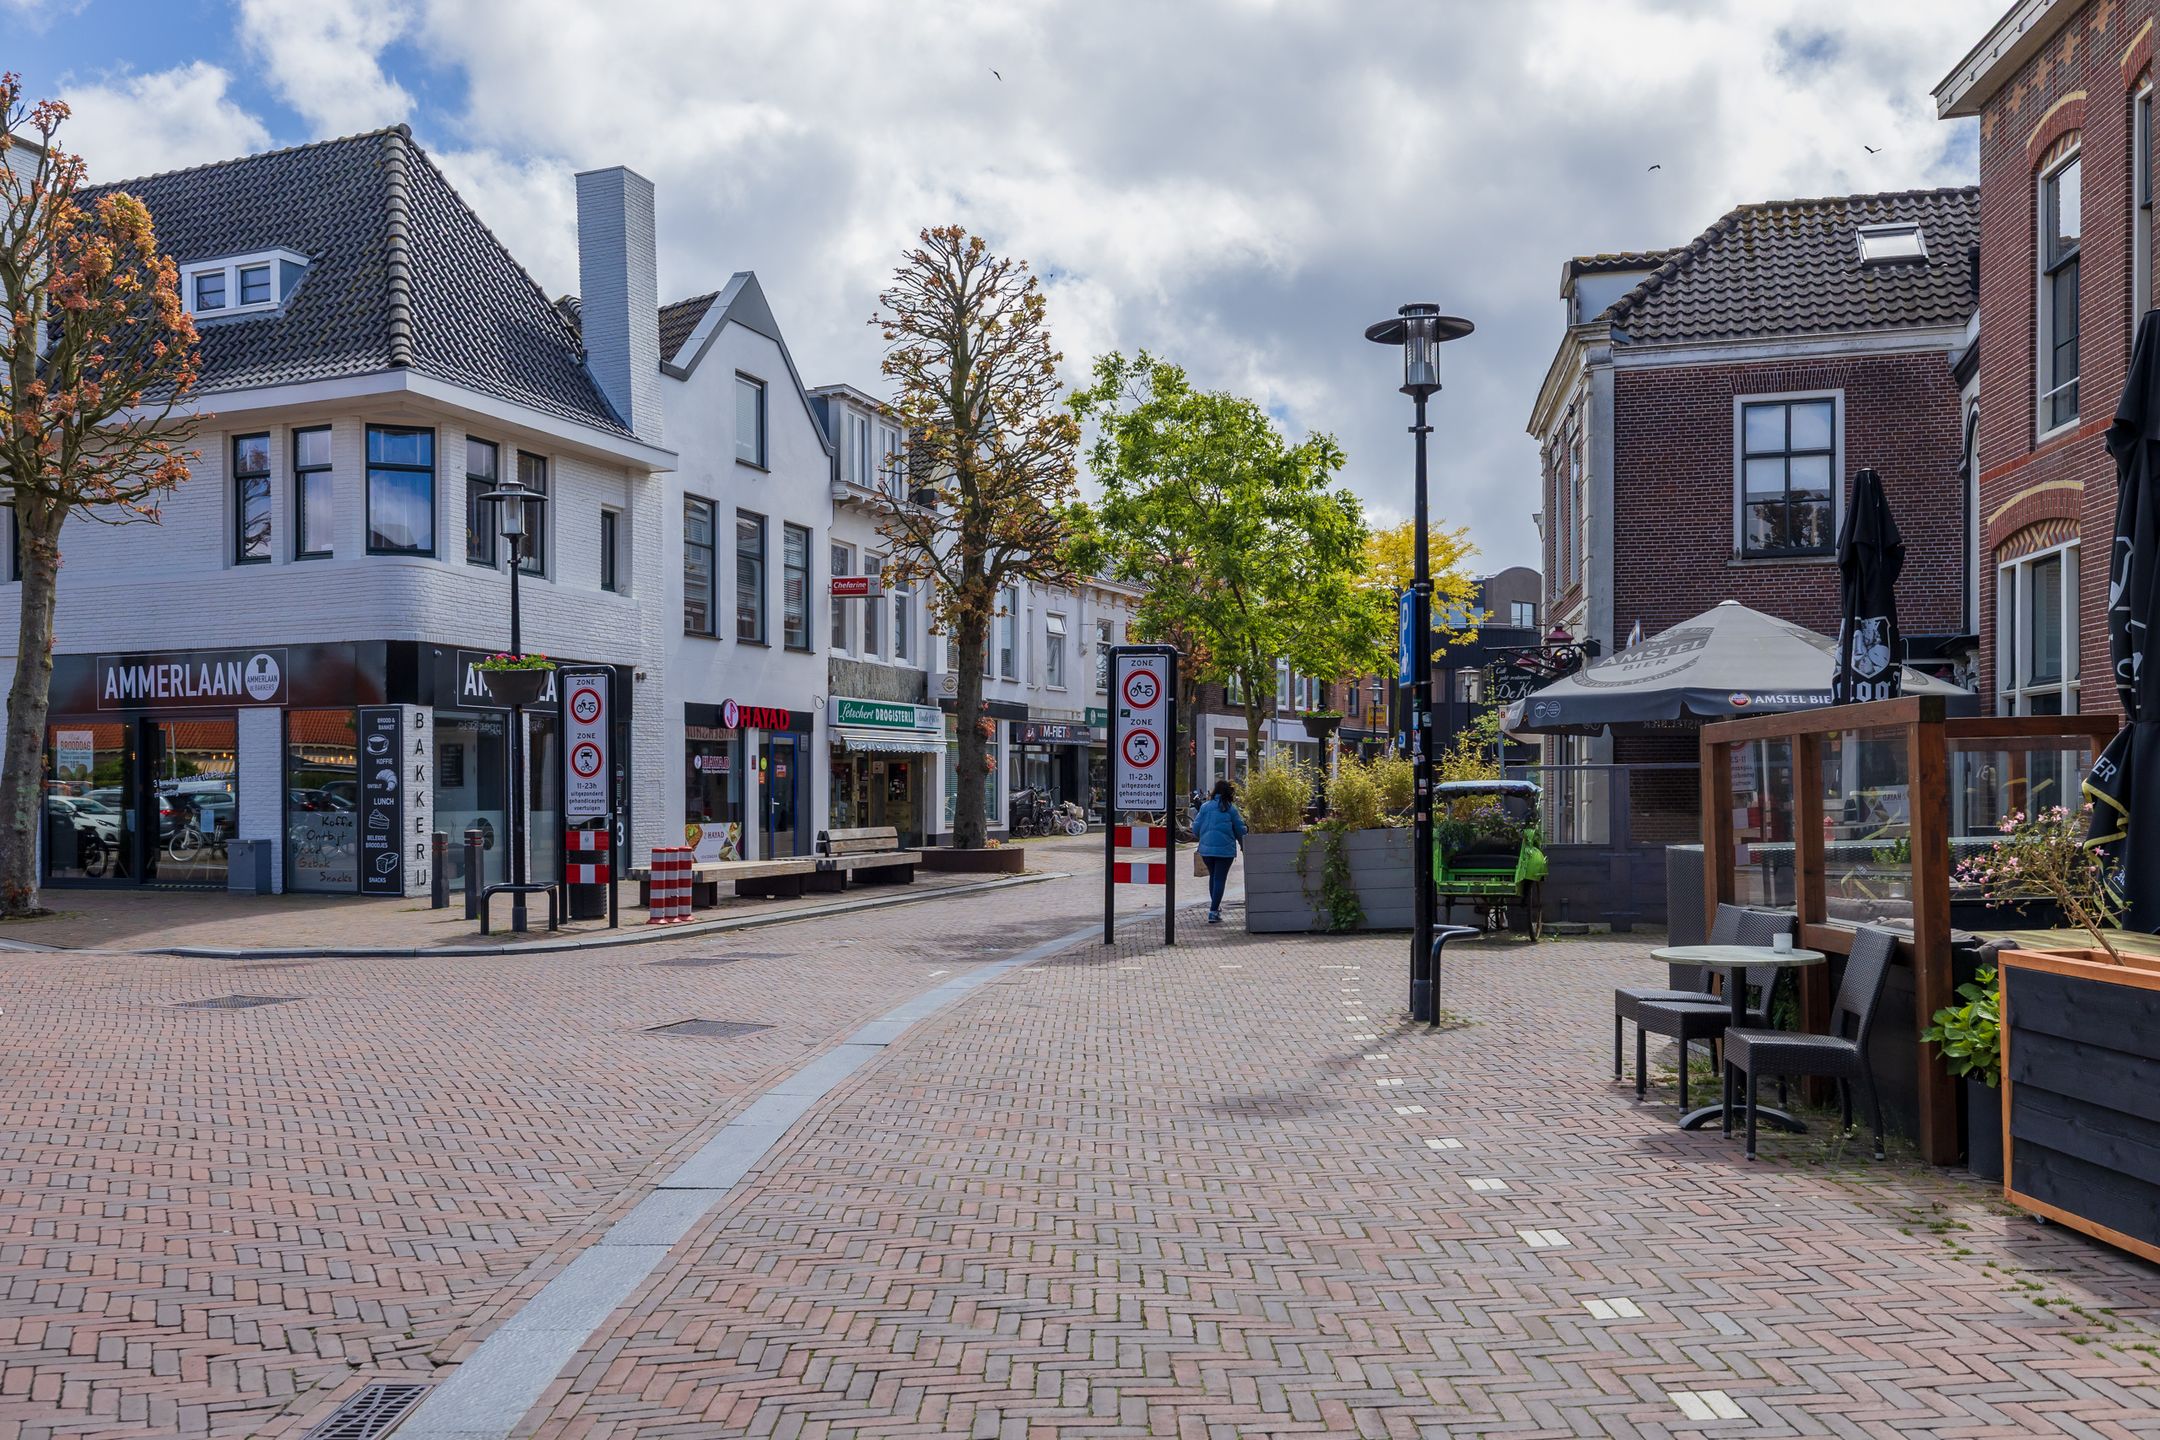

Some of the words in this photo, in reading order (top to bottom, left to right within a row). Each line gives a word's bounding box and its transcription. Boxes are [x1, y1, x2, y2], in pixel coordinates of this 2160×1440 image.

[833, 581, 867, 589] Chefarine
[1598, 640, 1705, 666] AMSTEL
[1130, 659, 1154, 667] ZONE
[1622, 658, 1668, 671] BIER
[104, 661, 242, 699] AMMERLAAN
[247, 675, 278, 683] AMMERLAAN
[1495, 681, 1516, 699] De
[1754, 695, 1806, 704] AMSTEL
[1809, 695, 1833, 704] BIE
[840, 702, 874, 720] Letschert
[875, 708, 913, 723] DROGISTERIJ
[740, 705, 790, 731] HAYAD
[1130, 718, 1153, 726] ZONE
[1129, 773, 1153, 781] 11-23h
[1121, 782, 1161, 790] uitgezonderd
[1118, 790, 1163, 798] gehandicapten
[373, 797, 394, 805] LUNCH
[415, 712, 427, 886] BAKKERIJ
[321, 816, 353, 827] Koffie
[319, 872, 353, 882] Snacks
